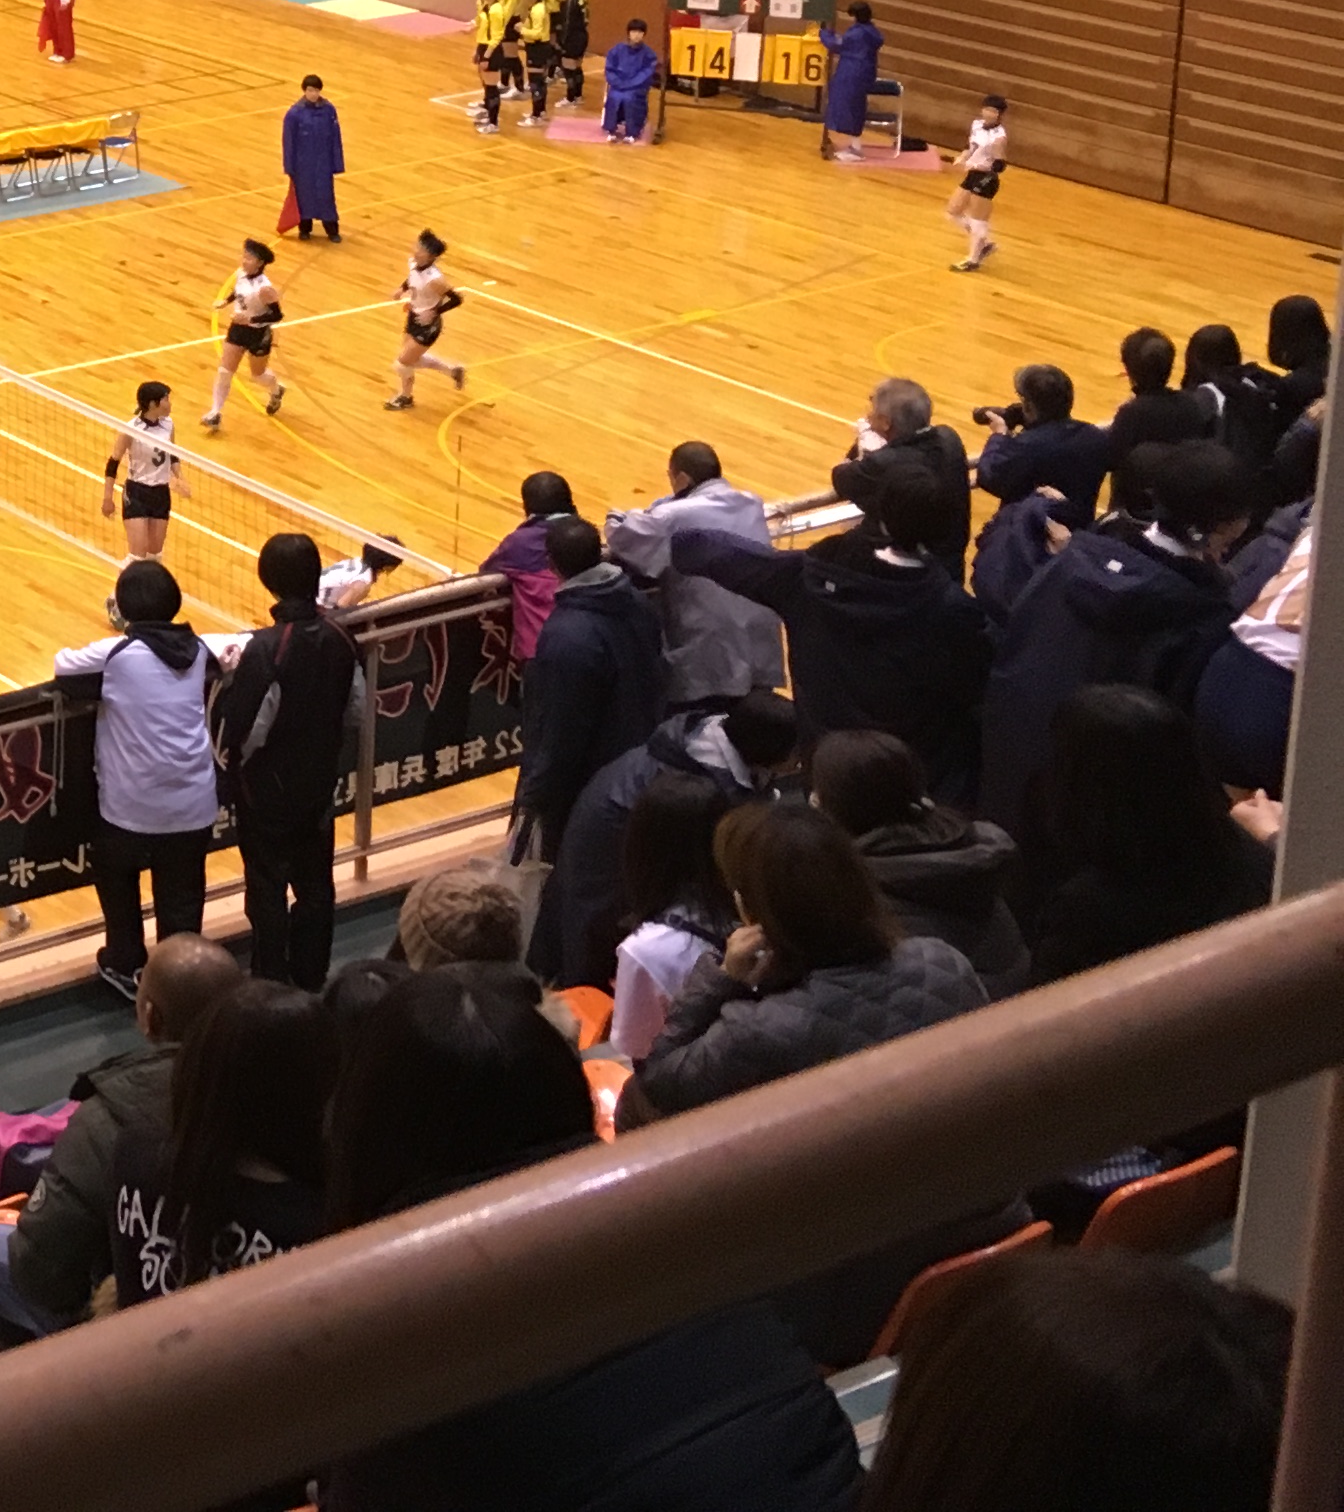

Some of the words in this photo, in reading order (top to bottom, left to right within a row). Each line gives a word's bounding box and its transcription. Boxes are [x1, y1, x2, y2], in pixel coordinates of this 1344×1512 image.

[687, 44, 726, 74] 14
[781, 51, 822, 82] 16
[151, 445, 166, 467] 3
